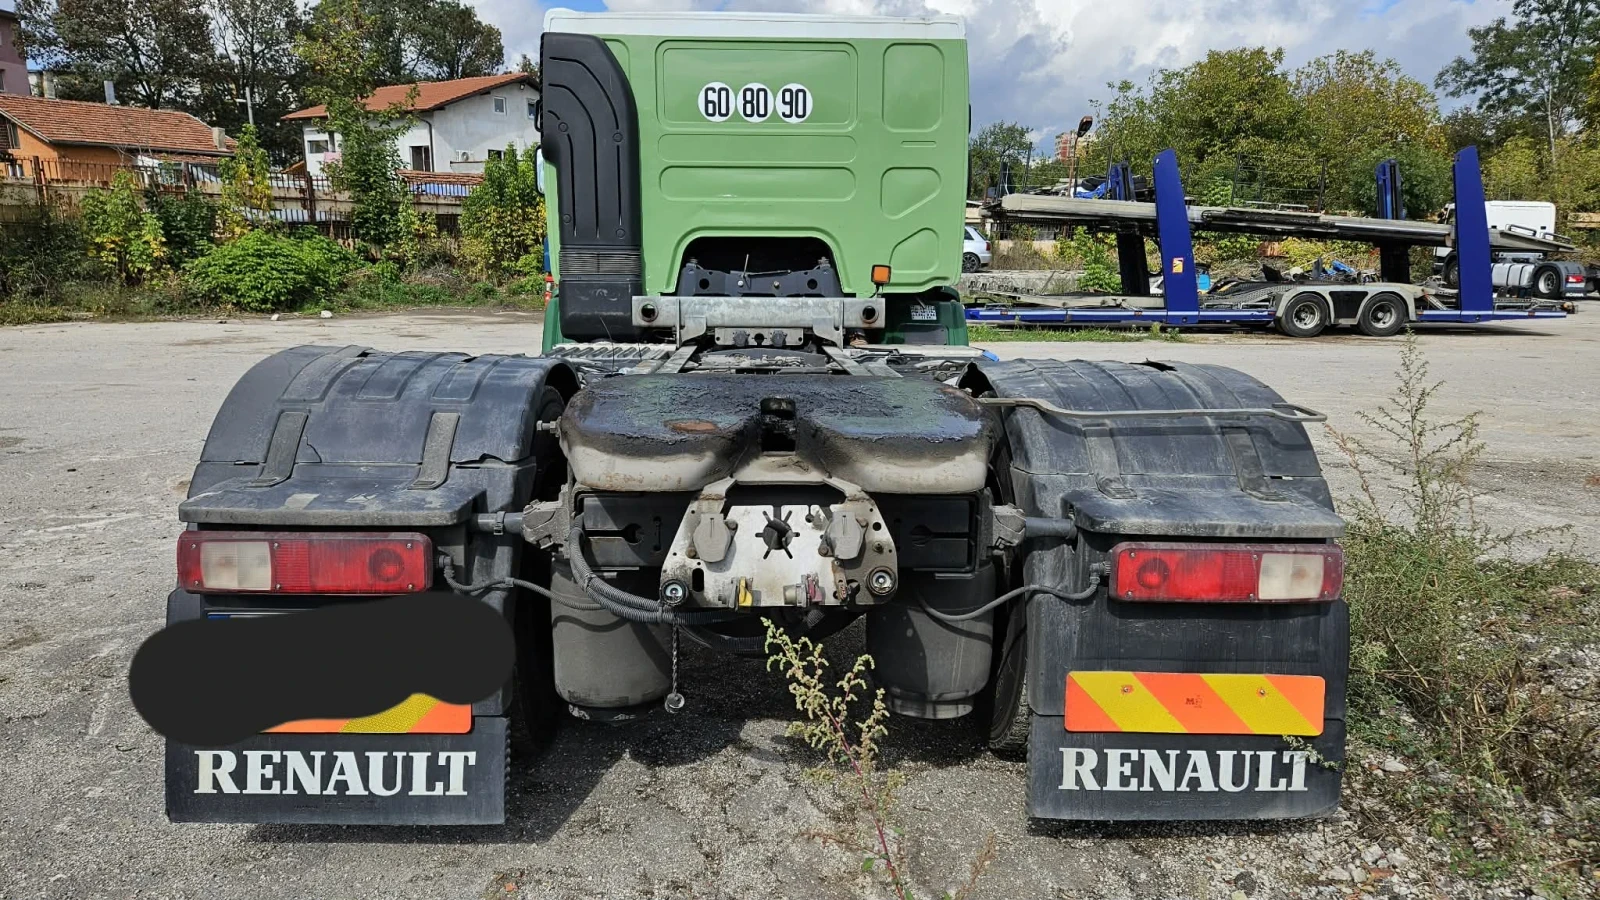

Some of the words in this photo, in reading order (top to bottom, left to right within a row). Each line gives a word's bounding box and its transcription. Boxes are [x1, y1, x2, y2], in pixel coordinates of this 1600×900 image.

[704, 86, 730, 118] 60
[742, 87, 768, 118] 80
[781, 88, 807, 119] 90
[193, 749, 477, 797] RENAULT
[1058, 747, 1318, 793] RENAULT
